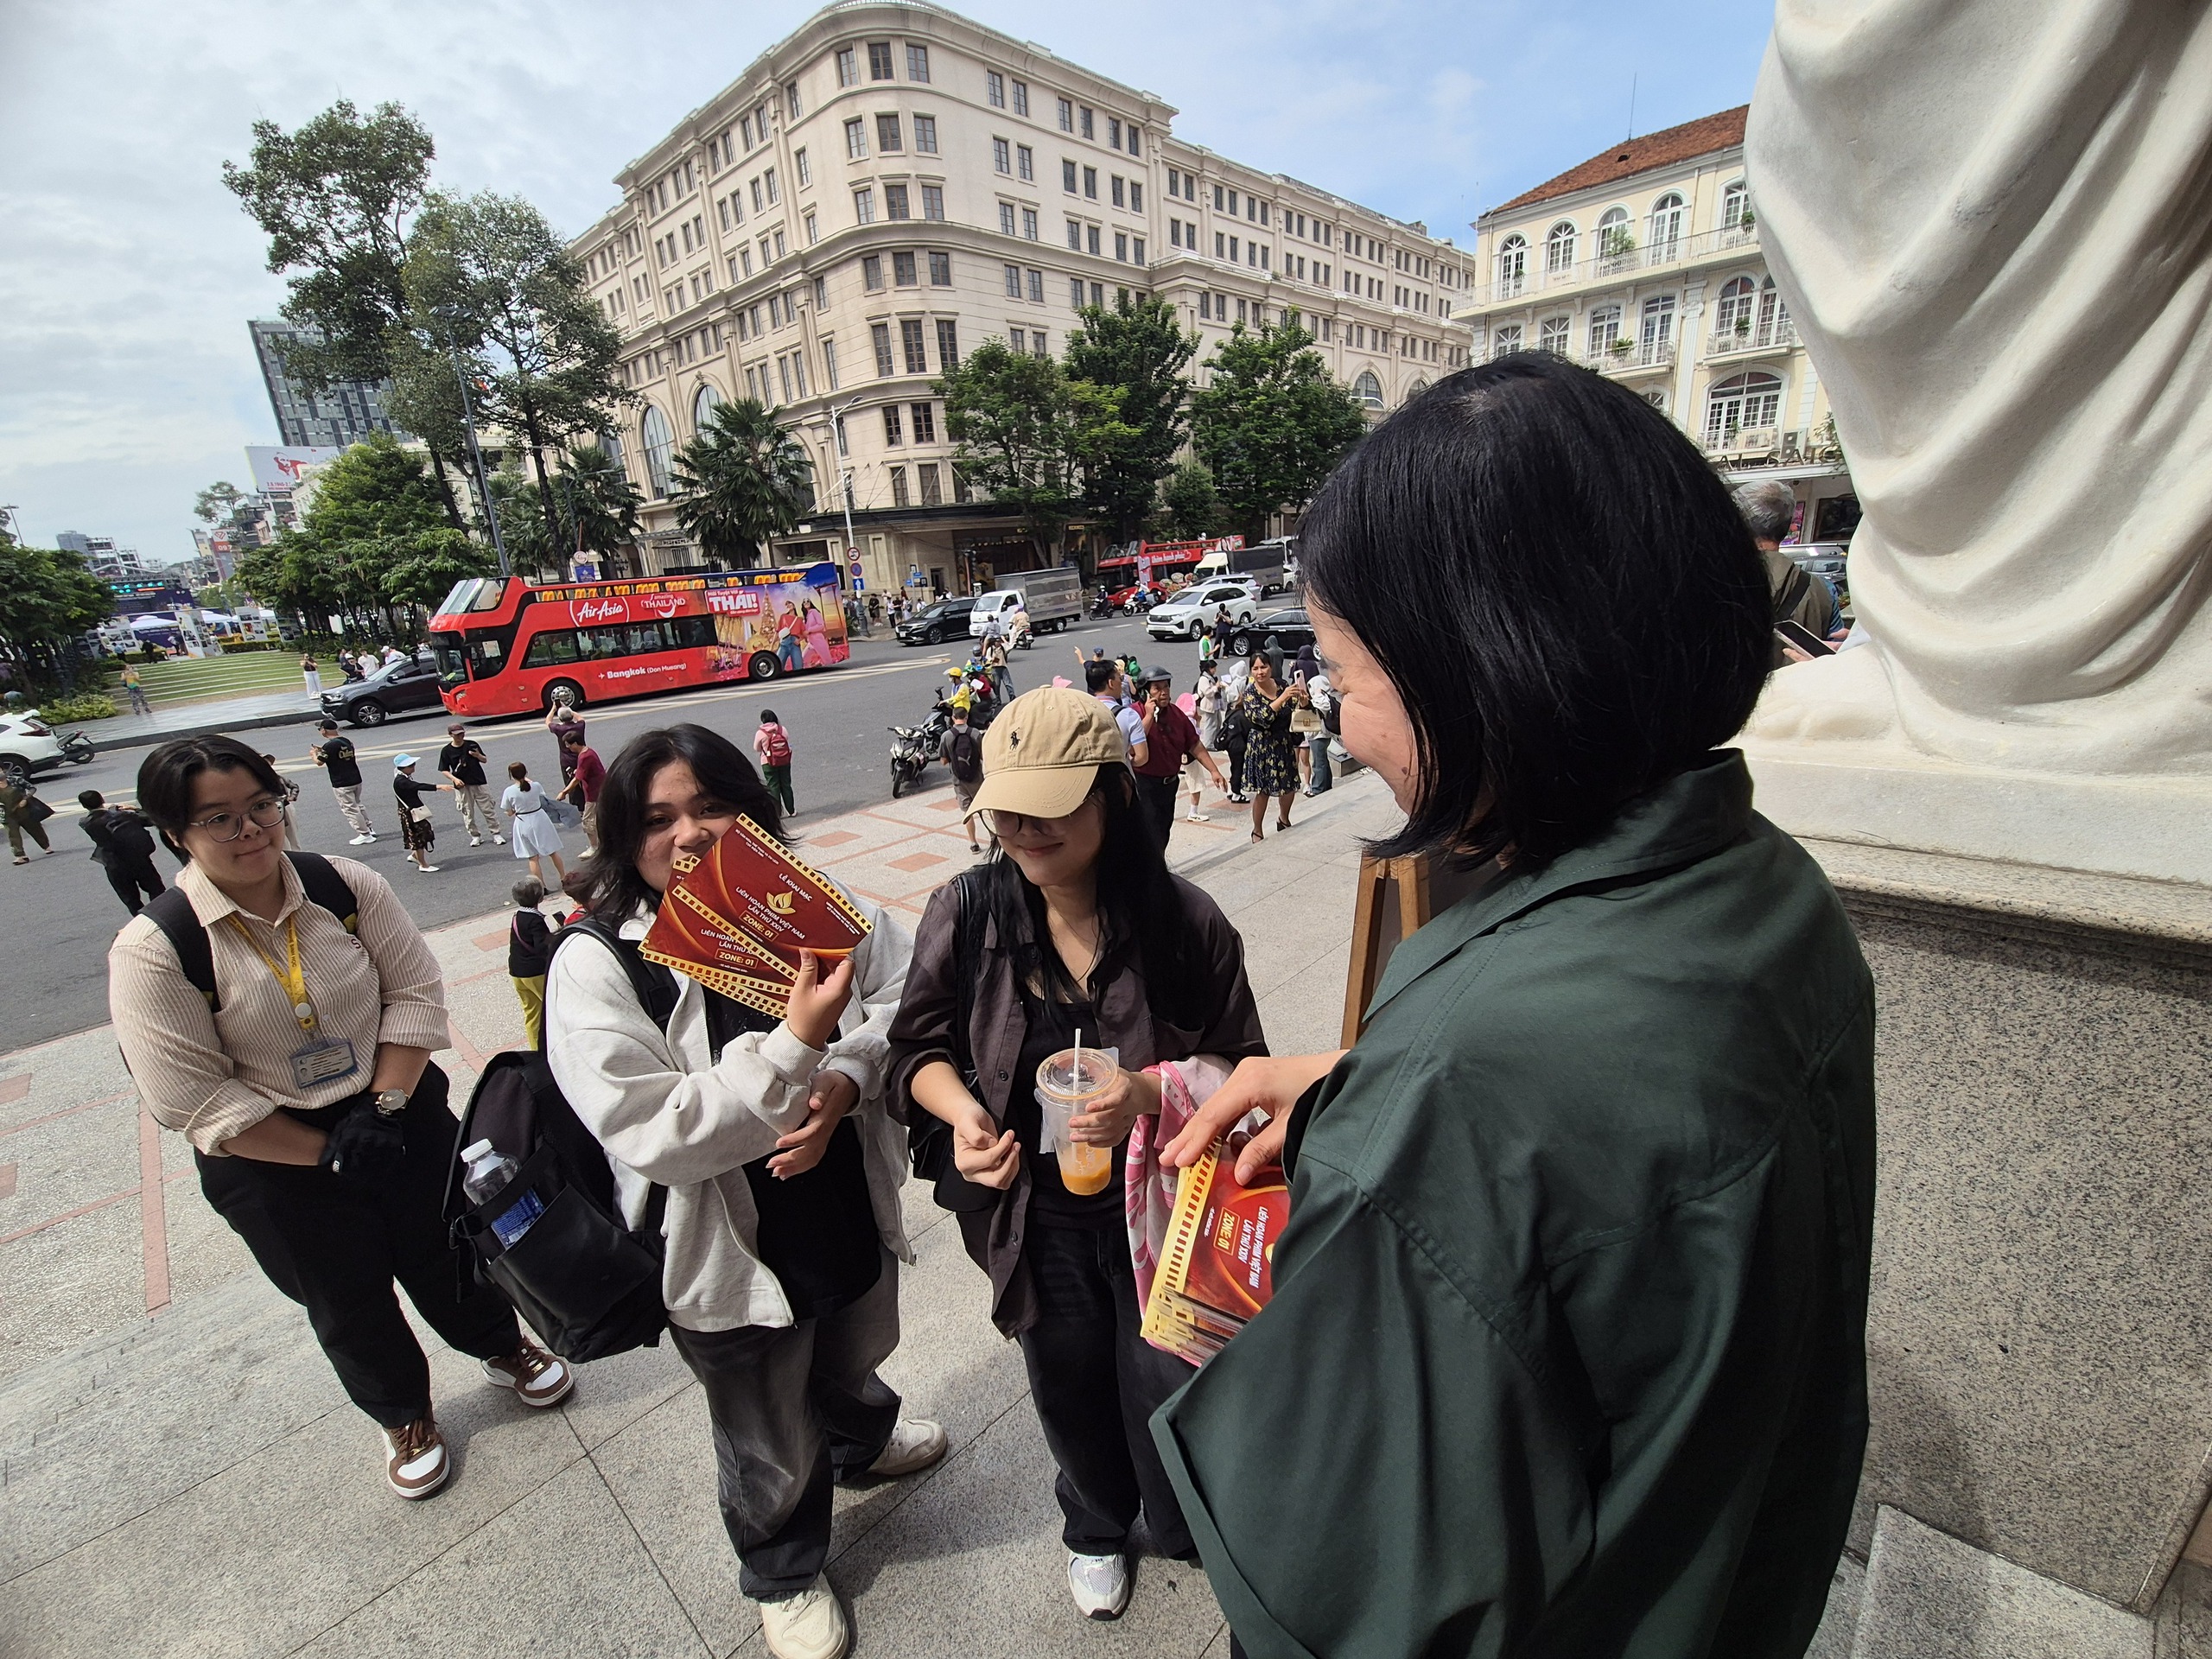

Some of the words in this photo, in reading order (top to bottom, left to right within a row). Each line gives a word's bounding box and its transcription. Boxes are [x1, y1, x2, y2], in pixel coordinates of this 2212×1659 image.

[644, 596, 686, 609] THAILAND
[607, 666, 646, 679] Bangkok
[646, 665, 663, 675] (Don
[786, 879, 801, 893] KHAI
[799, 890, 813, 902] MẠC
[735, 887, 749, 899] LIÊN
[748, 897, 766, 911] HOAN
[764, 908, 779, 921] PHIM
[779, 918, 793, 930] VIỆT
[791, 927, 805, 939] NAM
[701, 928, 715, 938] LIÊN
[743, 914, 765, 933] ZONE:
[764, 930, 774, 939] 01
[719, 951, 744, 963] ZONE:
[1258, 1206, 1269, 1223] LIÊN
[1220, 1212, 1235, 1240] ZONE:
[1255, 1220, 1267, 1240] HOAN
[1217, 1236, 1230, 1249] 01
[1252, 1238, 1263, 1258] PHIM
[1249, 1255, 1262, 1274] VIỆT
[1249, 1270, 1260, 1288] NAM
